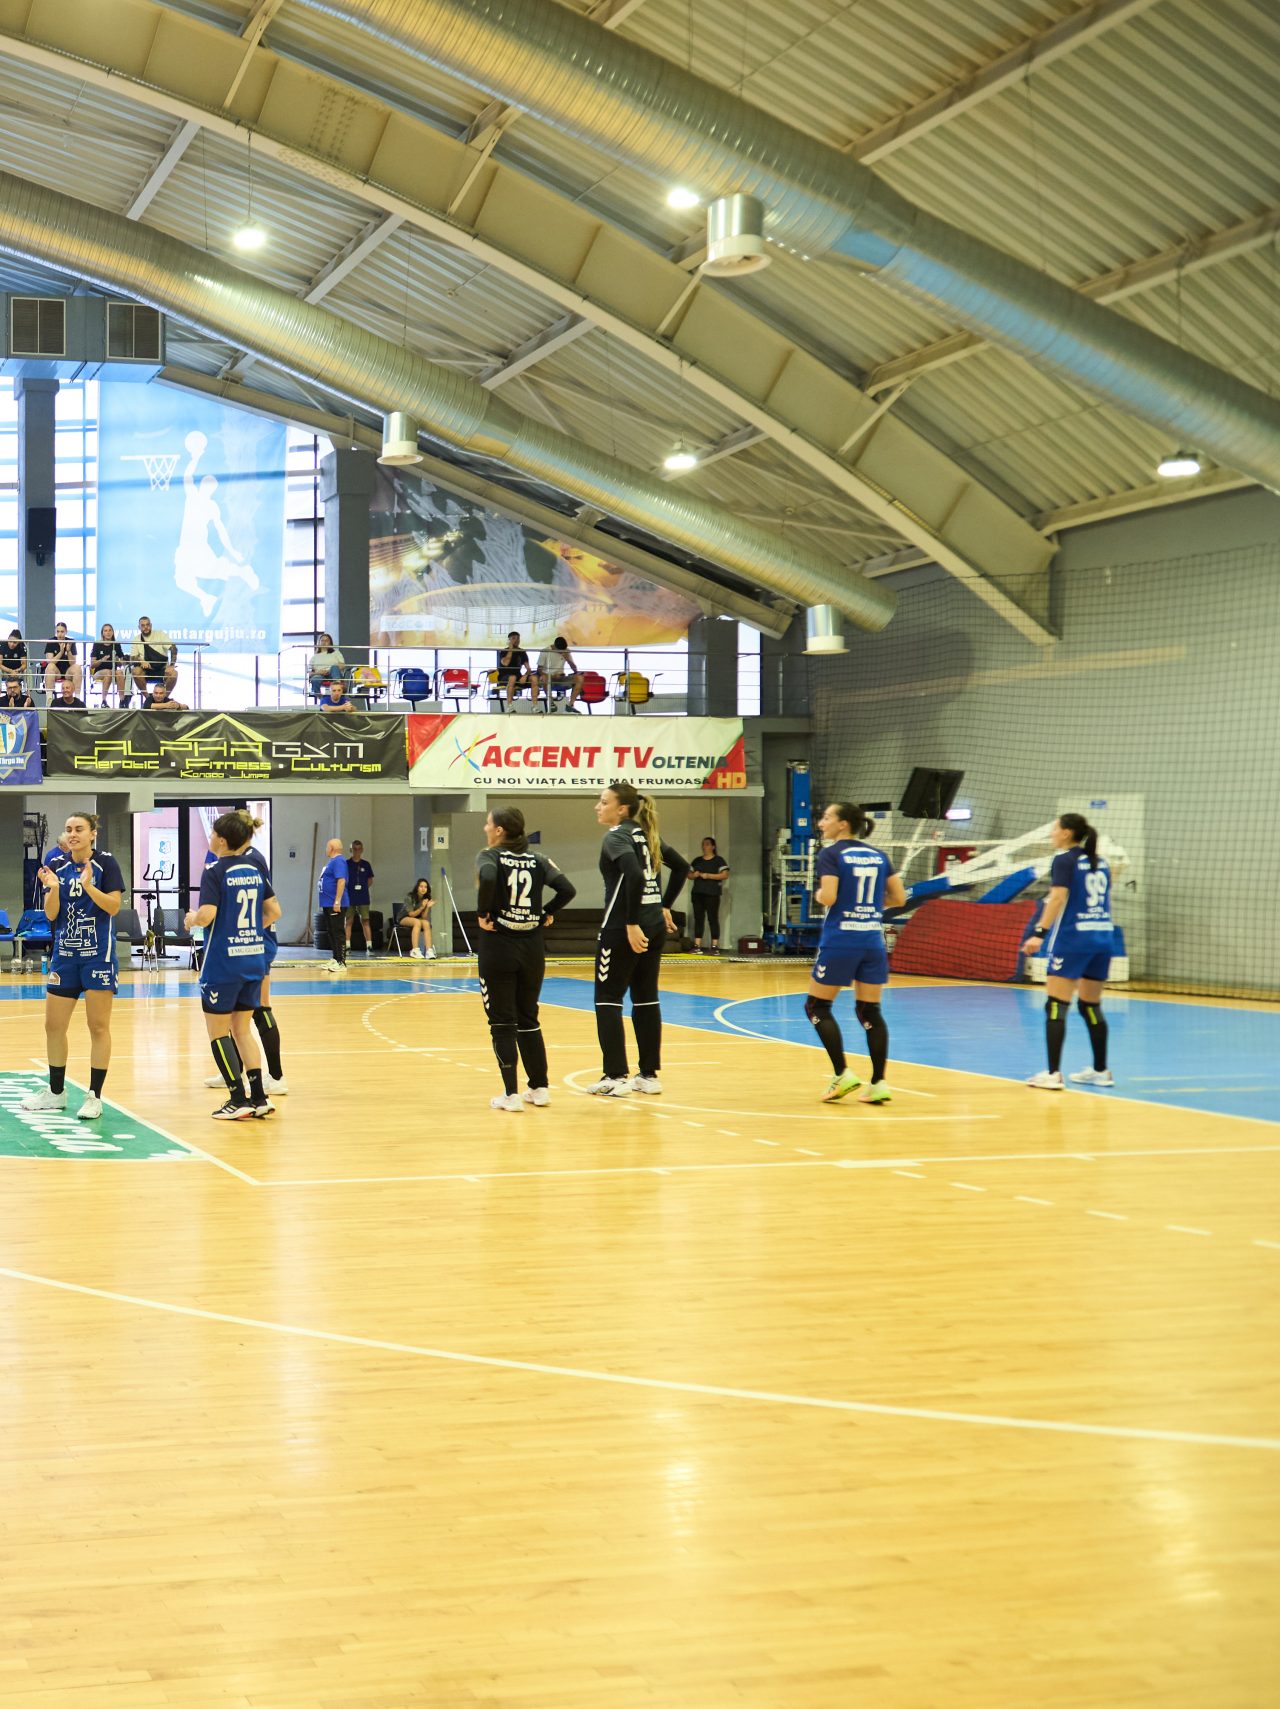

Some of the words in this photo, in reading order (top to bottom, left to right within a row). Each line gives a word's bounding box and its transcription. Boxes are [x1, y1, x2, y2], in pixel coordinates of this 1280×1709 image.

[94, 739, 263, 757] ALPHA
[481, 745, 602, 769] ACCENT
[74, 756, 160, 770] Aerobic
[185, 757, 272, 771] Fitness
[290, 757, 382, 773] Culturism
[473, 777, 492, 785] CU
[496, 777, 522, 785] NOI
[717, 772, 747, 788] HD
[69, 878, 83, 897] 25
[507, 868, 533, 907] 12
[853, 867, 878, 904] 77
[237, 888, 258, 929] 27
